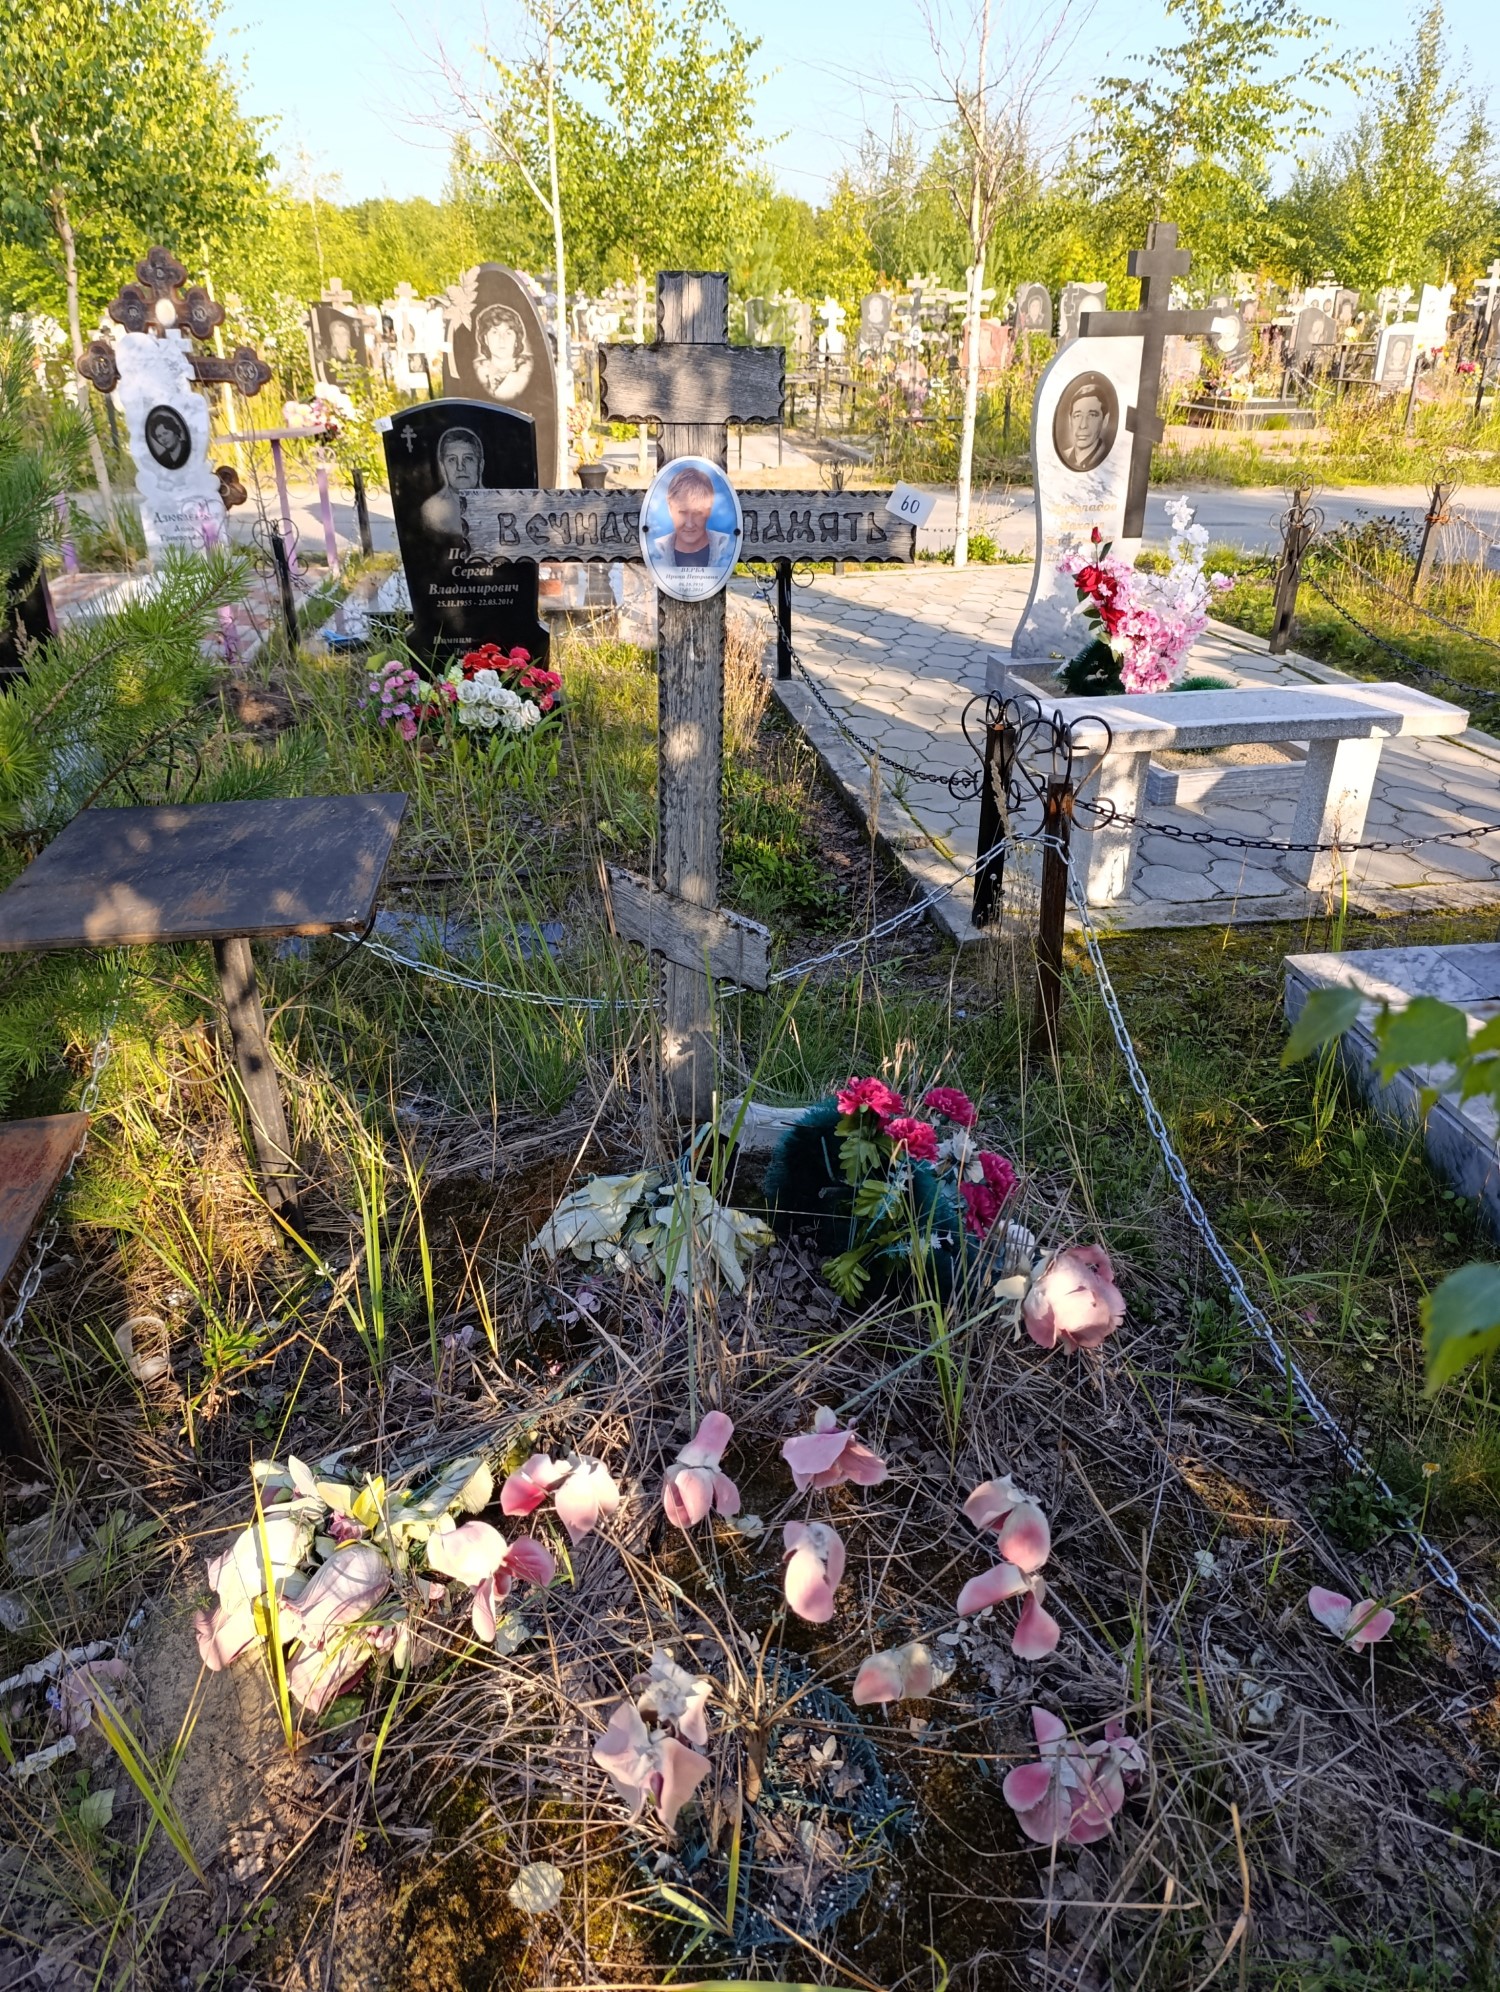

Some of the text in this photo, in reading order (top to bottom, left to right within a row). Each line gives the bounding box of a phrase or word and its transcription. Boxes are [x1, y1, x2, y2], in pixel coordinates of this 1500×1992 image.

[900, 495, 920, 514] 60
[497, 509, 888, 546] ВЕЧНАЯ ПАМЯТЬ
[451, 565, 494, 579] Сергей
[428, 583, 519, 595] Владимирович
[437, 600, 473, 608] 25.11.1955
[478, 598, 514, 606] 22.03.2014
